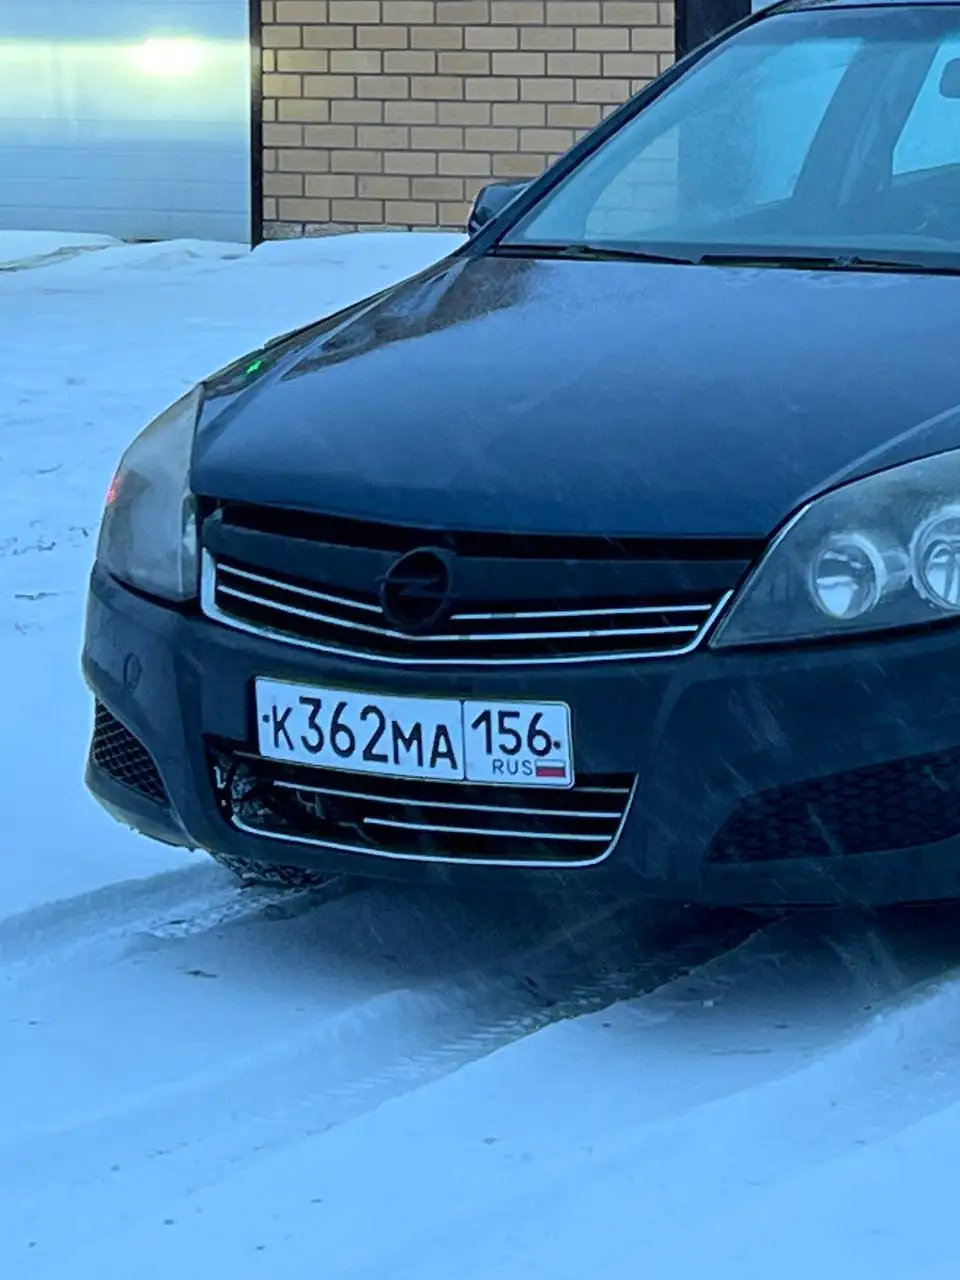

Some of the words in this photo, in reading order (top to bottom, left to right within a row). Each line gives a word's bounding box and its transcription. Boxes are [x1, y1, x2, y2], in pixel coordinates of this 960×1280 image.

[271, 696, 458, 769] К362МА
[471, 709, 552, 756] 156
[492, 759, 533, 776] RUS
